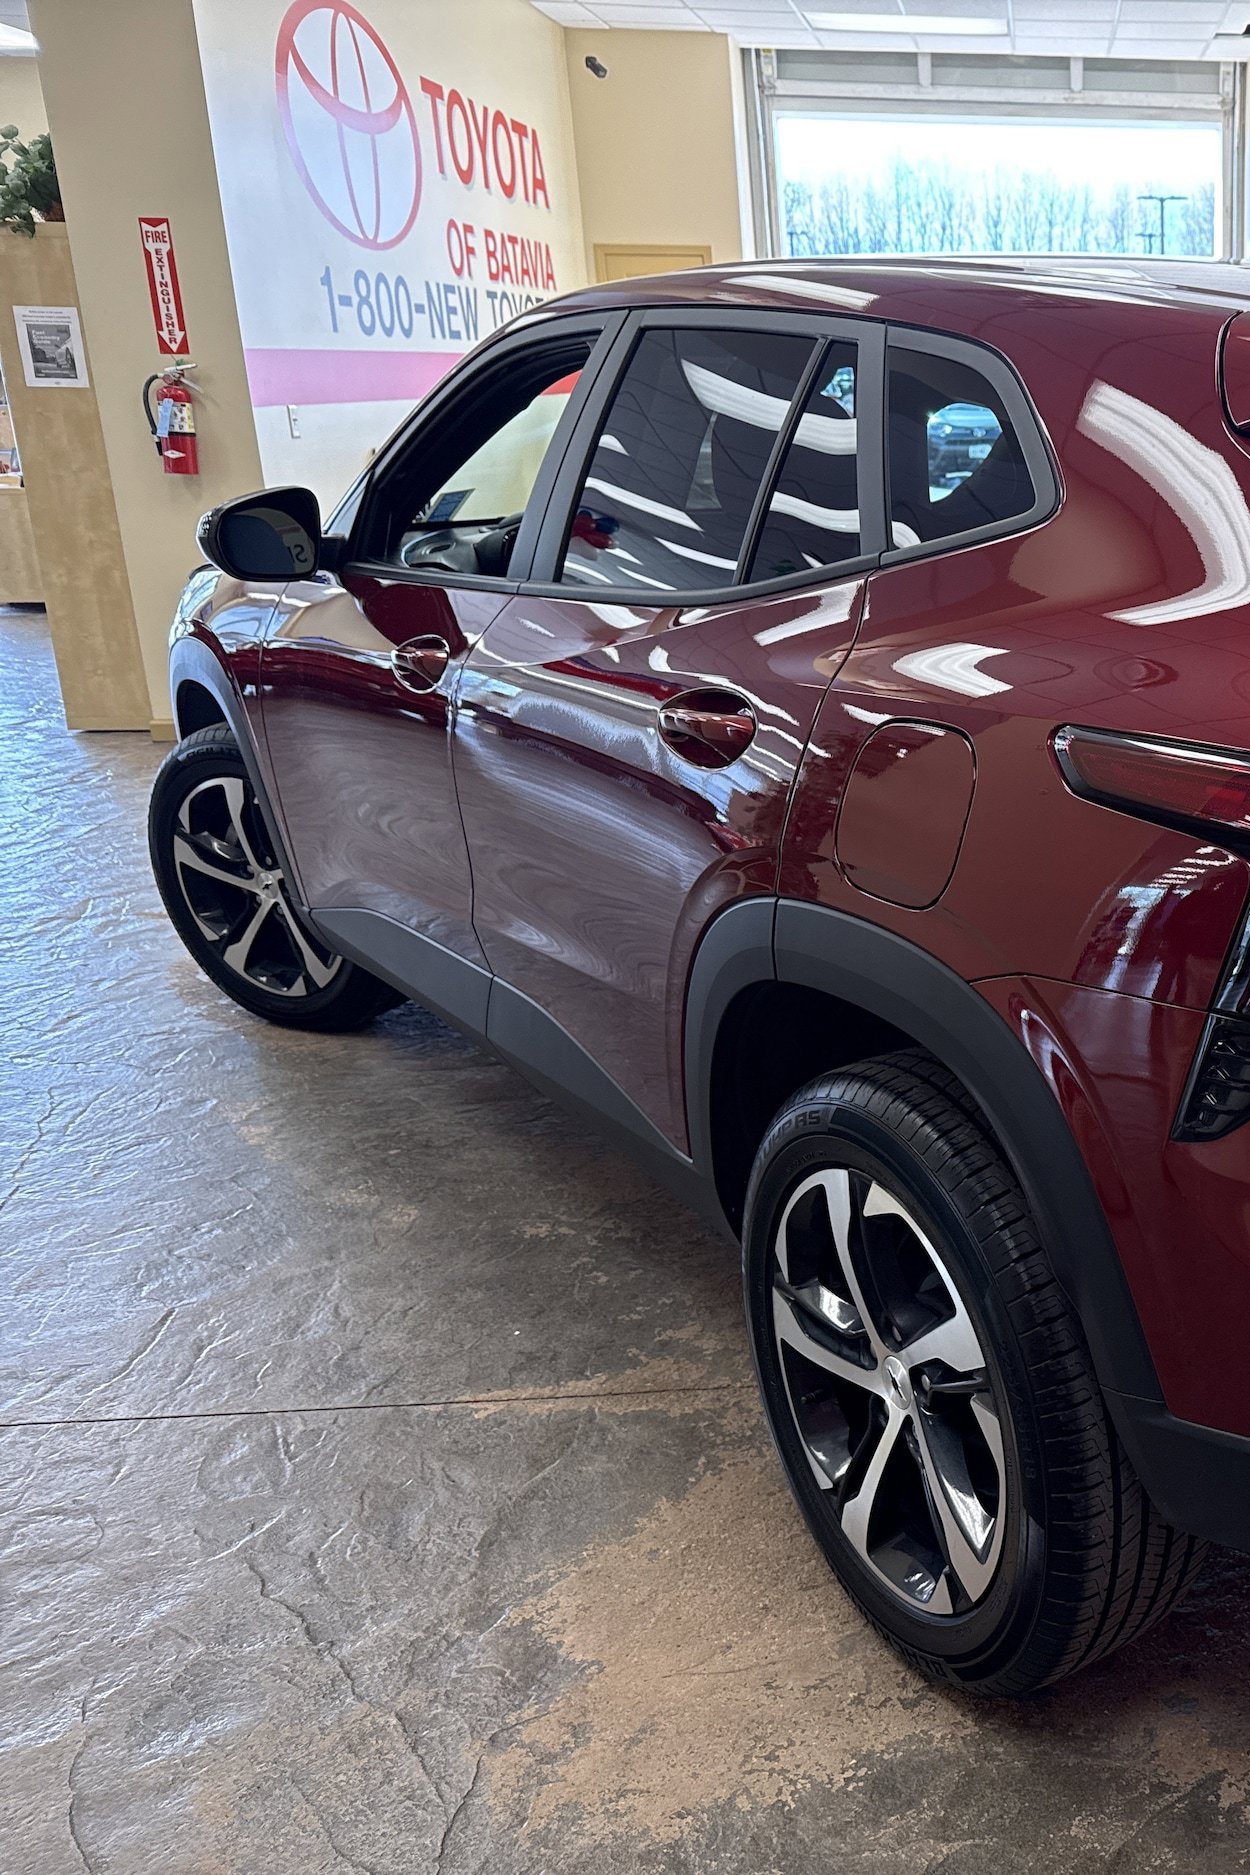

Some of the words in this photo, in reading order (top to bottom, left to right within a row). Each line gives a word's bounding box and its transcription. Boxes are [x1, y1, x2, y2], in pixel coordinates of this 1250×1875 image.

[420, 76, 550, 209] TOYOTA
[144, 230, 168, 243] FIRE
[447, 218, 476, 278] OF
[484, 229, 557, 291] BATAVIA
[155, 248, 178, 345] EXTINGUISHER
[320, 266, 479, 341] 1-800-NEW
